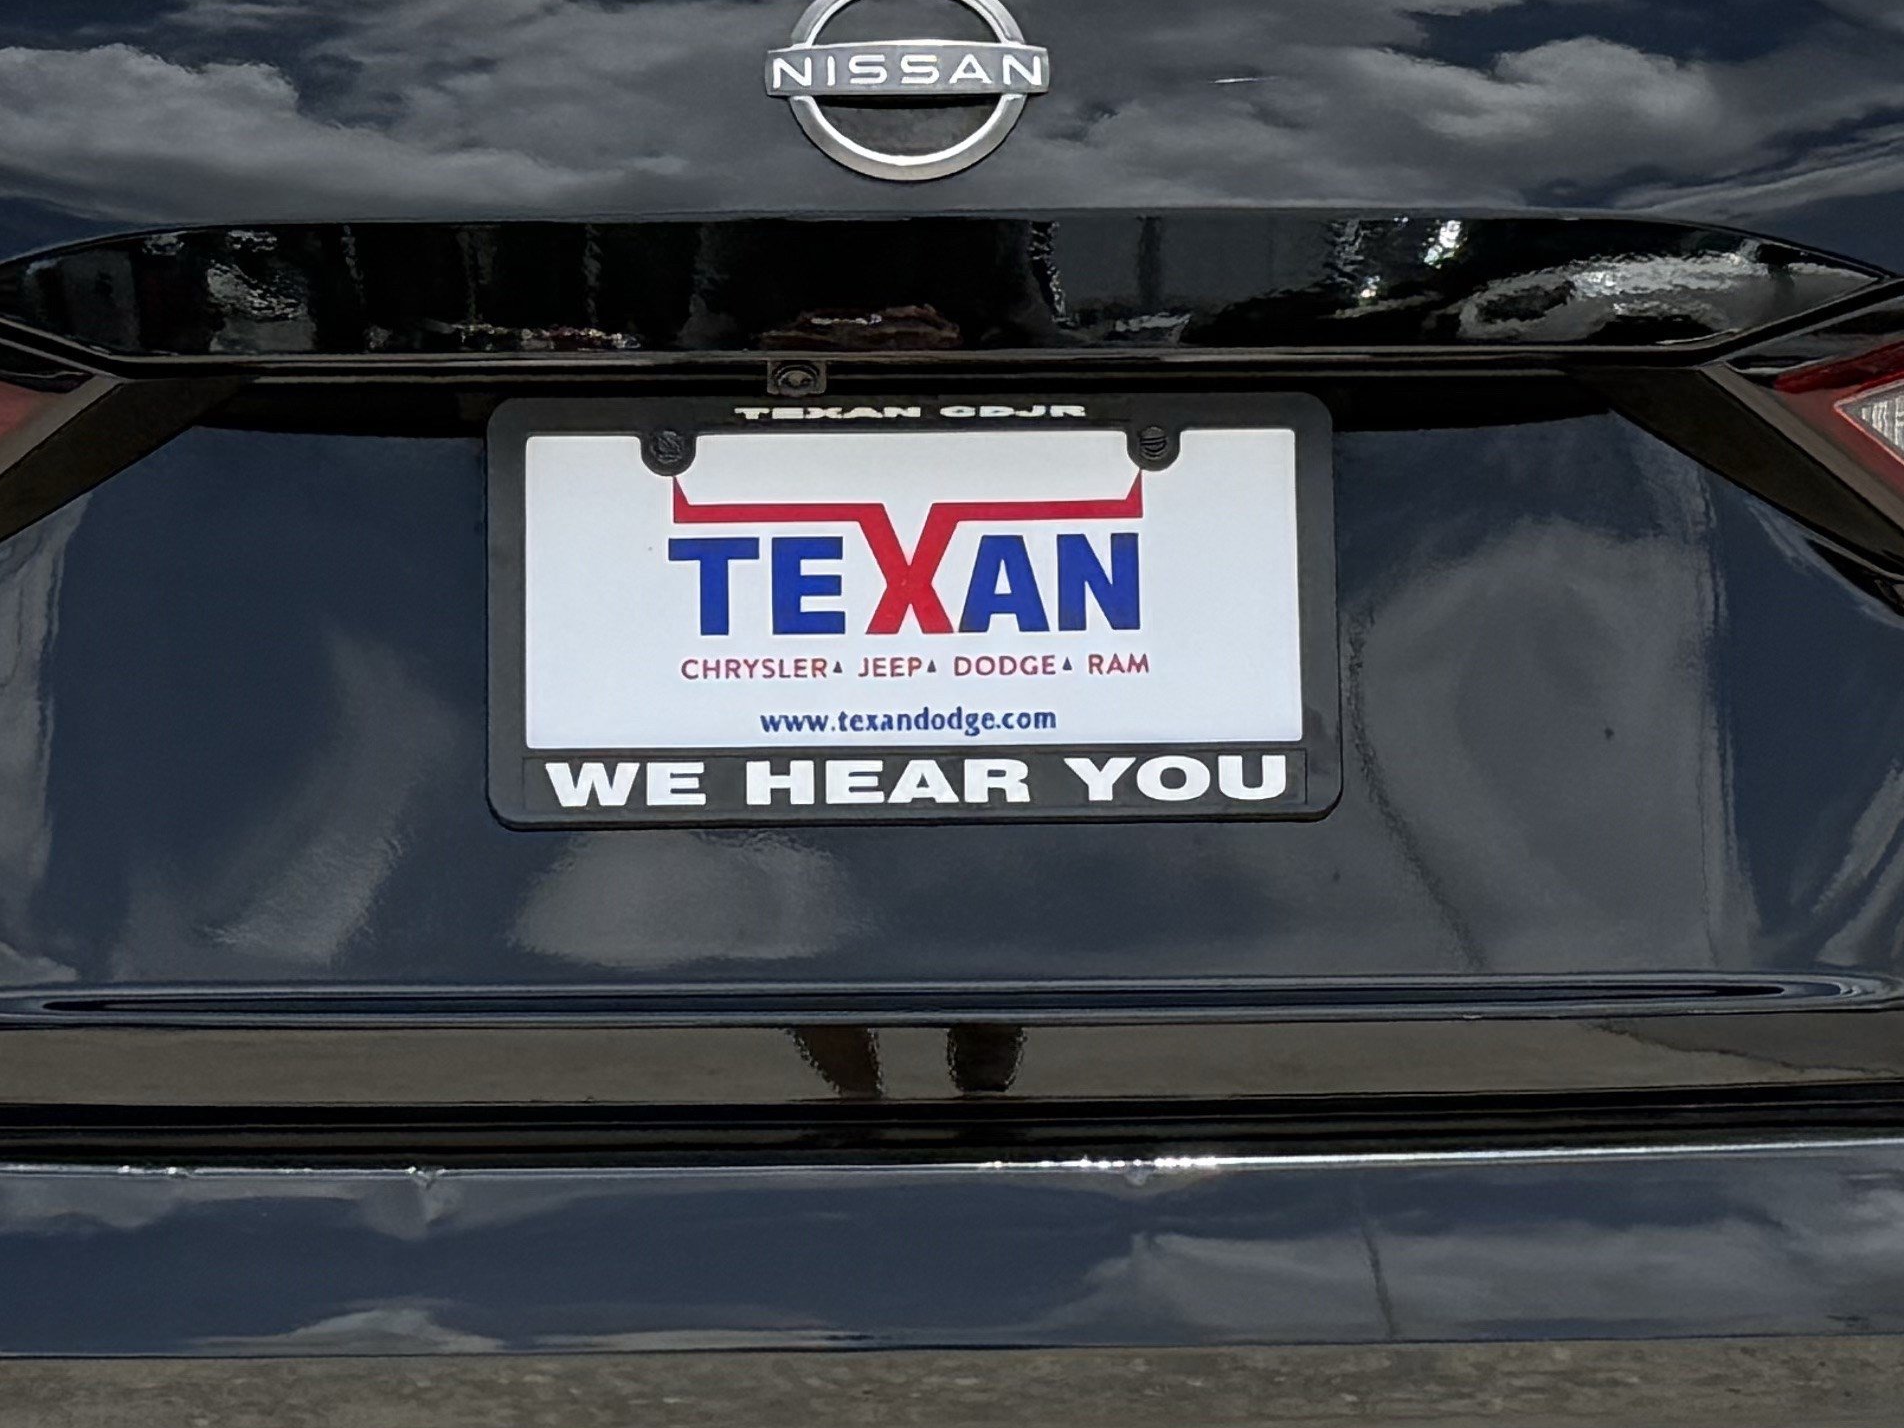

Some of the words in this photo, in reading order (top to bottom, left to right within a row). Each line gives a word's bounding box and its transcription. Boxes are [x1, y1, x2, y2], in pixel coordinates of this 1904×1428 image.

[772, 53, 1042, 89] NISSAN
[734, 406, 922, 420] TEXAN
[667, 503, 1142, 636] TEXAN
[681, 657, 828, 681] CHRYSLER
[857, 656, 924, 678] JEEP
[953, 653, 1058, 677] DODGE
[1087, 652, 1151, 675] RAM
[759, 706, 1058, 738] www.texandodge.com
[545, 761, 707, 807] WE
[745, 759, 1033, 806] HEAR
[1063, 754, 1287, 802] YOU
